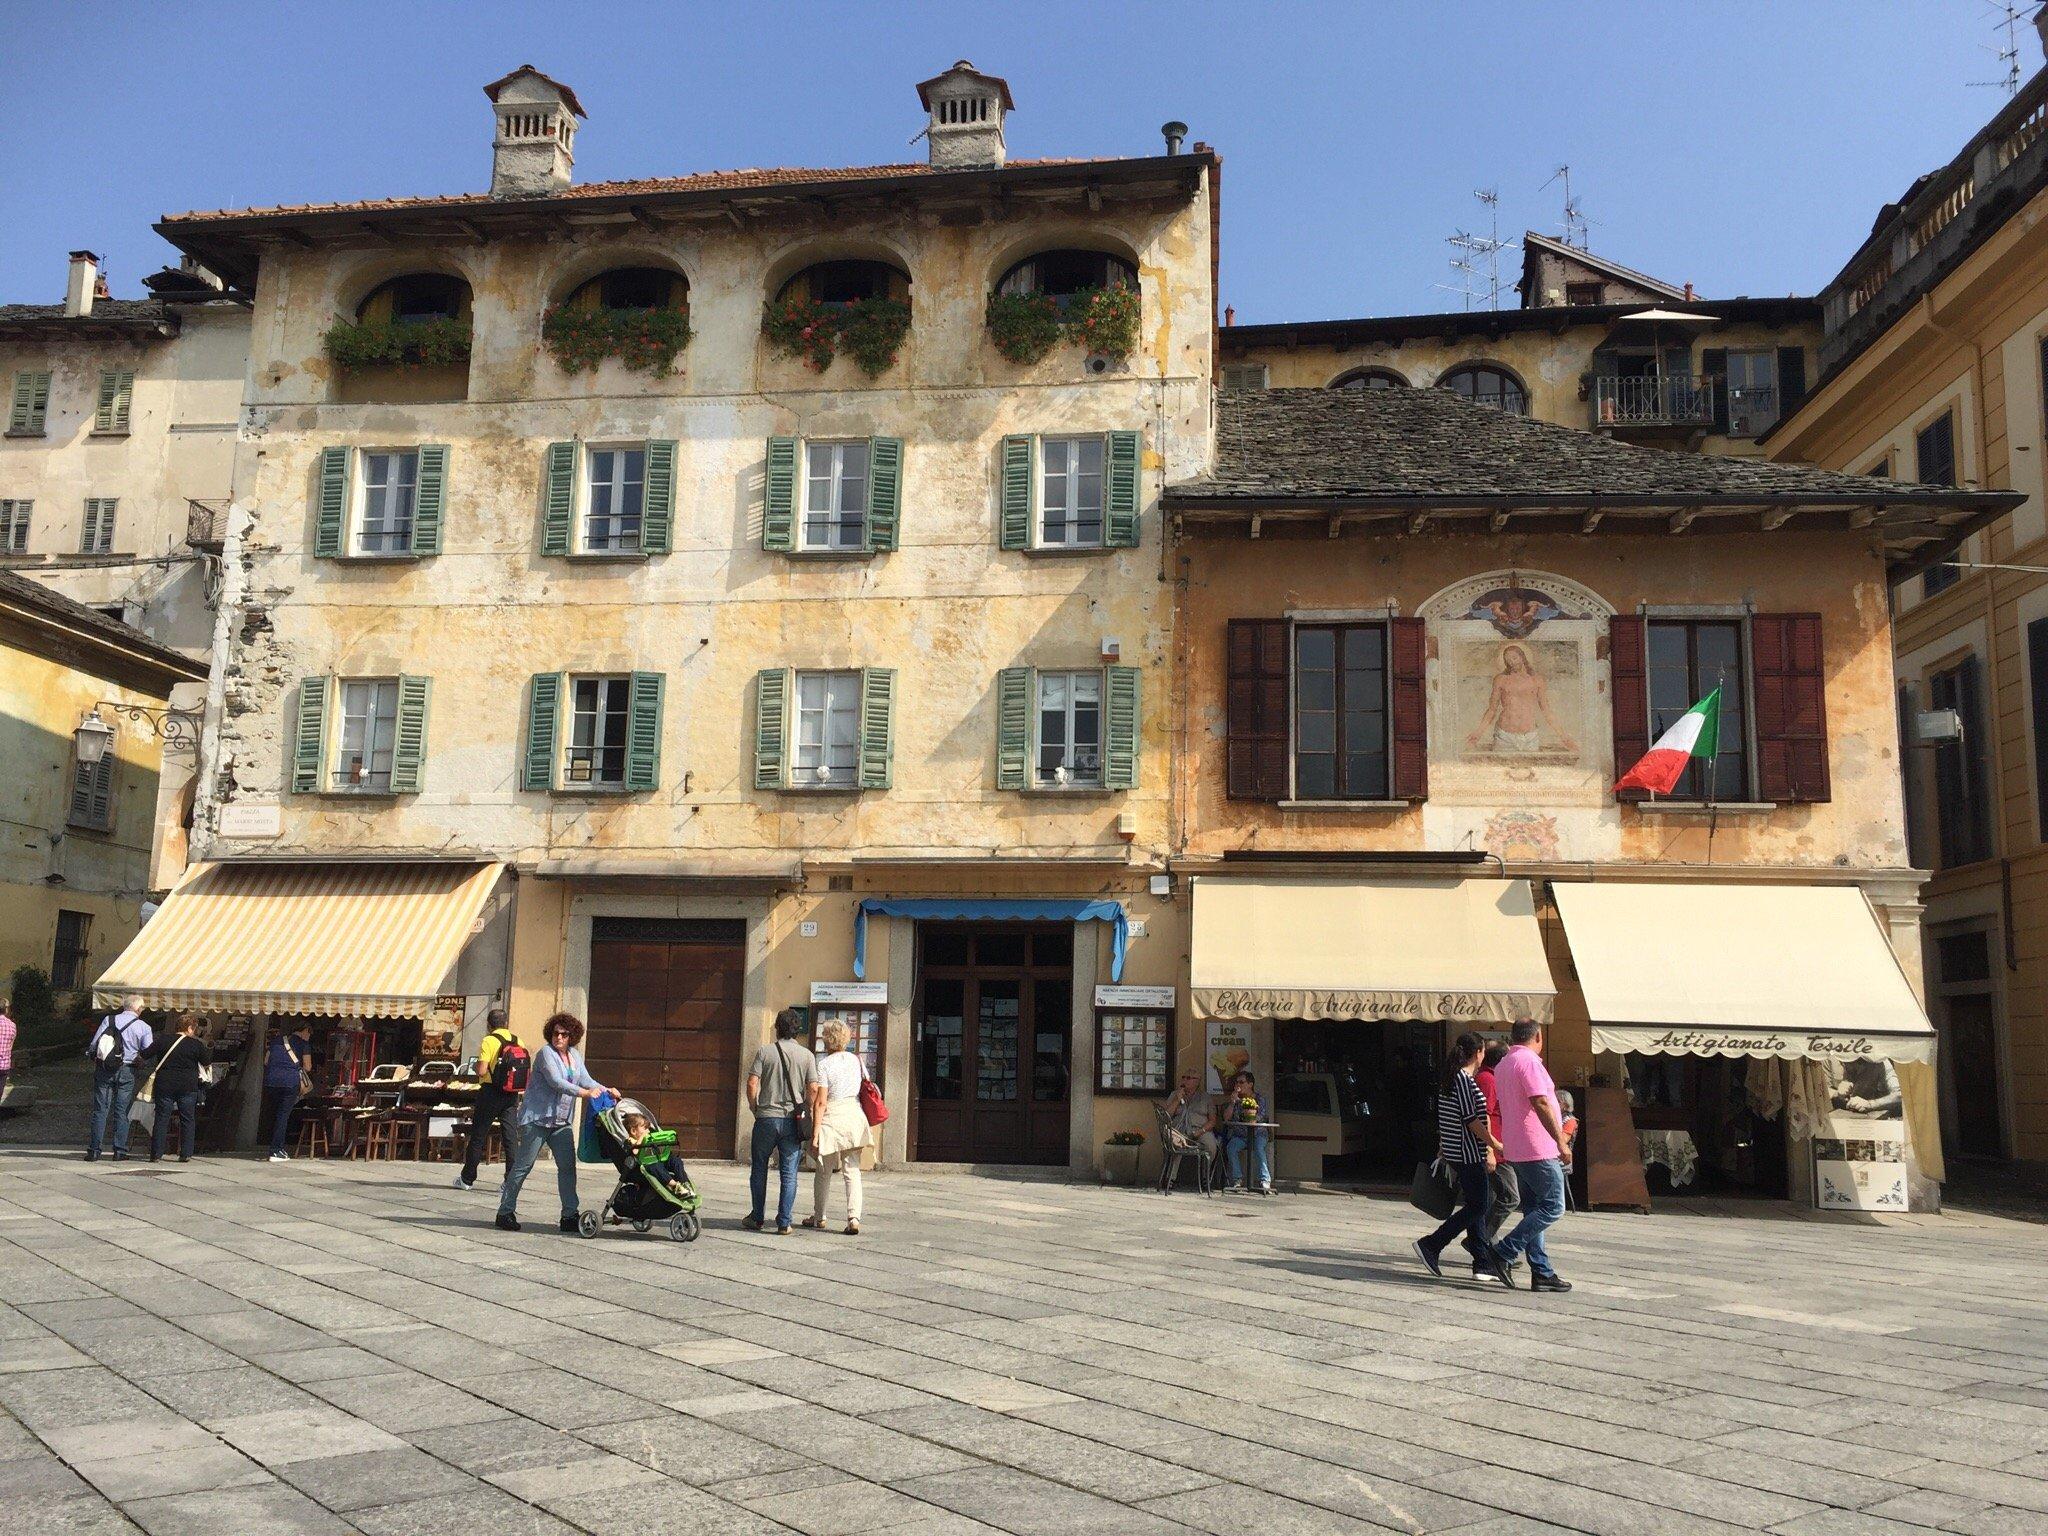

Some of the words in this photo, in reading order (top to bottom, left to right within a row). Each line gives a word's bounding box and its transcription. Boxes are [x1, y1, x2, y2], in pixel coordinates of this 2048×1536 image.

[1214, 991, 1294, 1015] Gelateria
[1310, 993, 1418, 1018] Artigianale
[1437, 994, 1486, 1016] Eliot
[1219, 1024, 1237, 1036] ice
[1210, 1036, 1246, 1047] cream
[1650, 1030, 1787, 1054] Artigianato
[1806, 1035, 1874, 1054] Tessile
